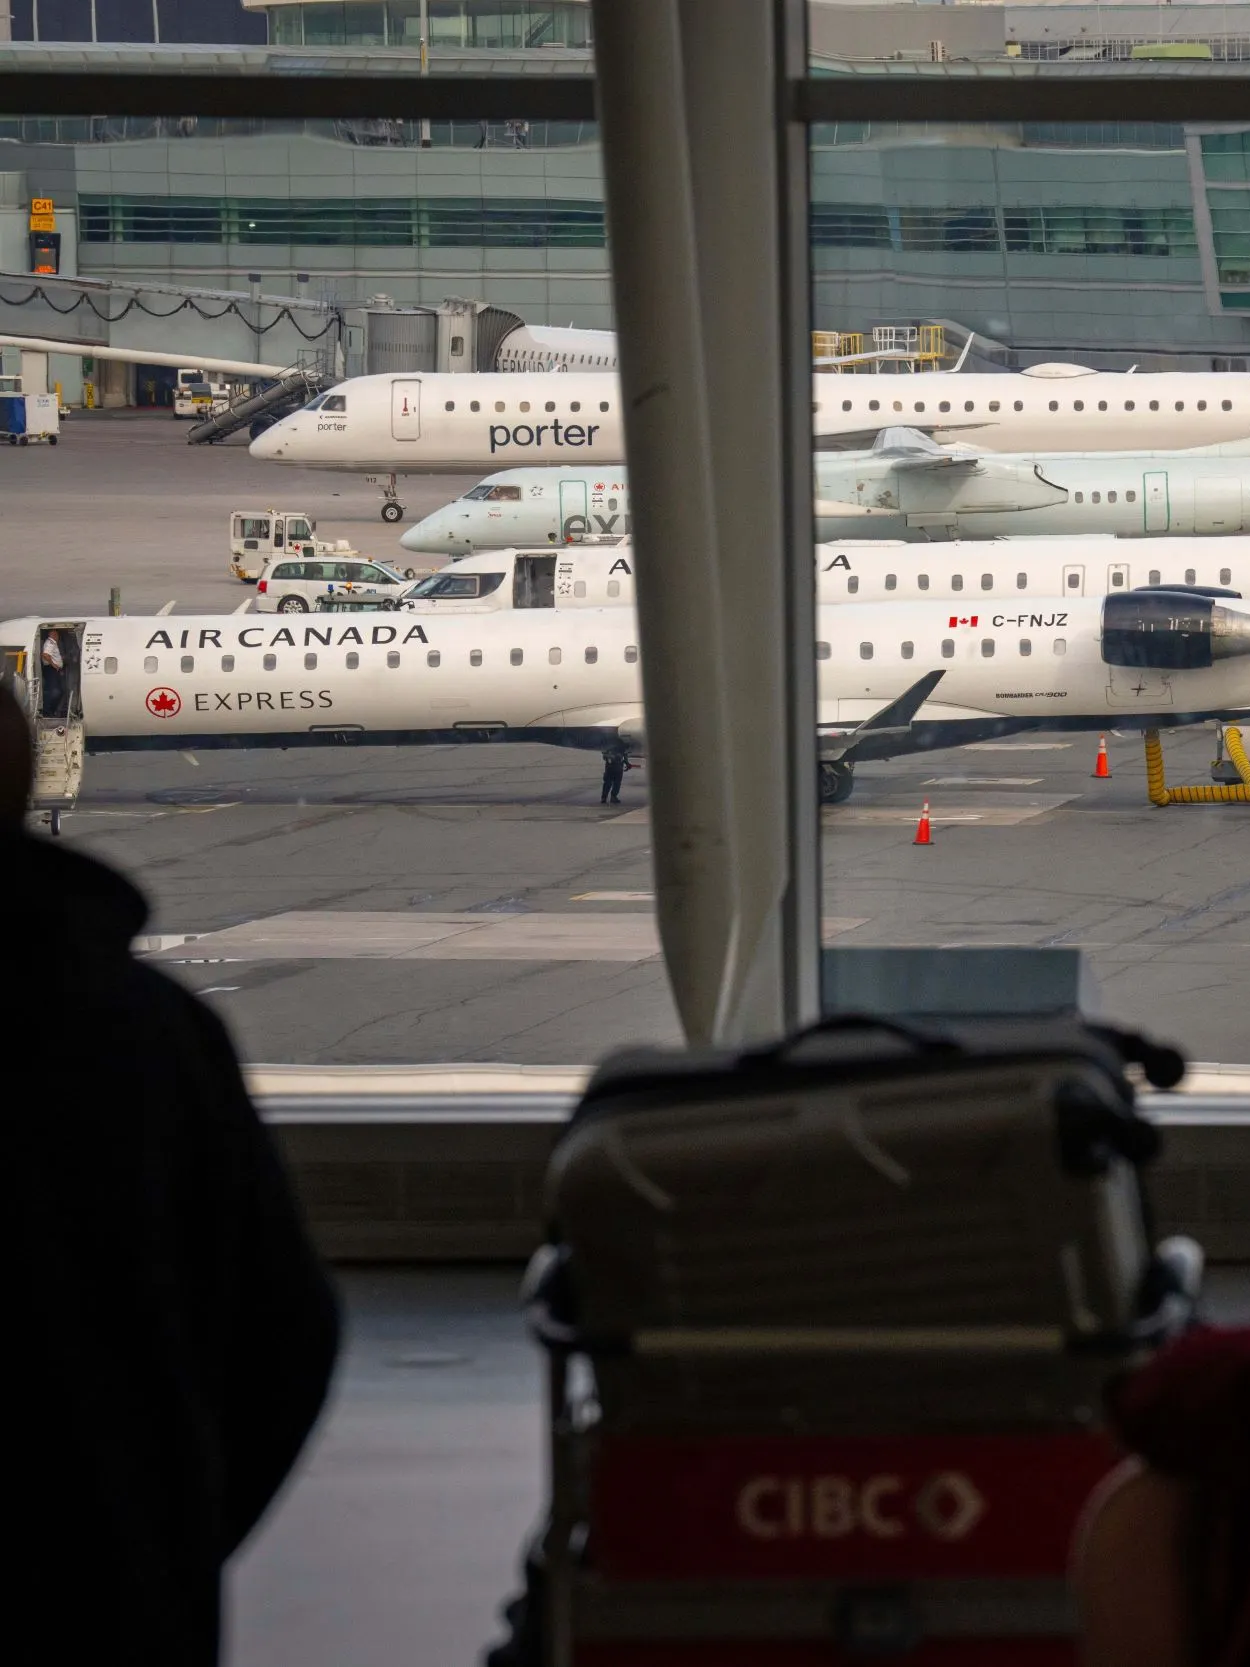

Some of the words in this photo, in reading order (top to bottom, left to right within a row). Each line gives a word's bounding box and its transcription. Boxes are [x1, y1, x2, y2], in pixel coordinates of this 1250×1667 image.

[34, 202, 51, 210] C41
[317, 422, 347, 432] porter
[489, 418, 600, 454] porter
[992, 613, 1068, 627] C-FNJZ
[145, 628, 223, 649] AIR
[237, 624, 429, 648] CANADA
[194, 690, 333, 711] EXPRESS
[735, 1472, 906, 1541] CIBC
